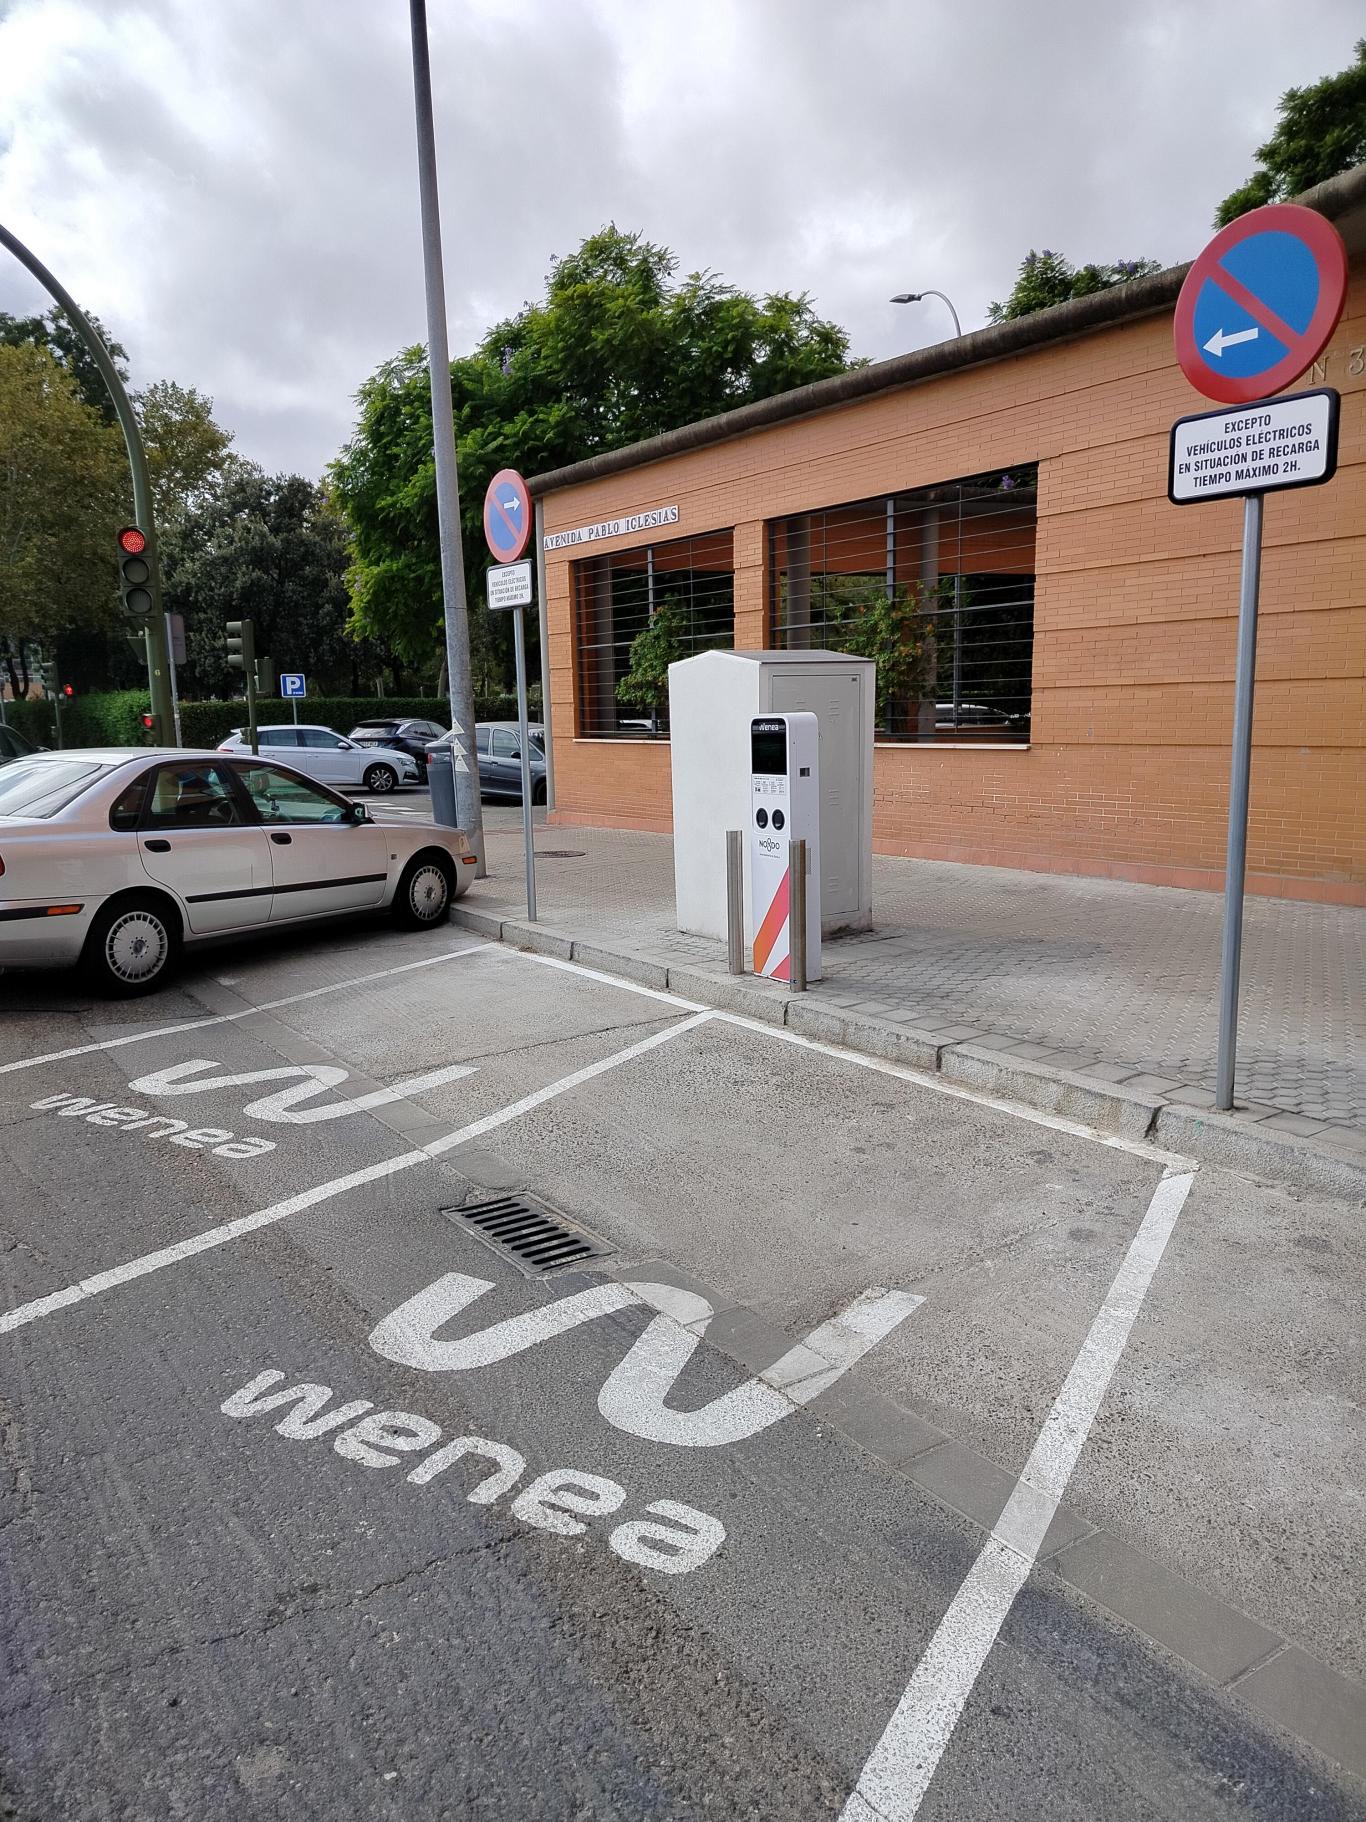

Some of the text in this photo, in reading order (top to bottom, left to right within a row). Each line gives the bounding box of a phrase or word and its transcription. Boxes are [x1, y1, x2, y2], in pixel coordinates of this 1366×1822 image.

[1186, 423, 1312, 457] VEHÍCULOS ELÉCTRICOS
[1224, 414, 1271, 433] EXCEPTO
[1178, 439, 1320, 474] EN SITUACIÓN DE RECARGA
[1193, 460, 1301, 487] TIEMPO MÁXIMO 2H.
[544, 507, 677, 549] AVENIDA PABLO IGLESIAS
[286, 677, 301, 695] P
[29, 1092, 277, 1160] wenea
[219, 1368, 728, 1575] wenea
